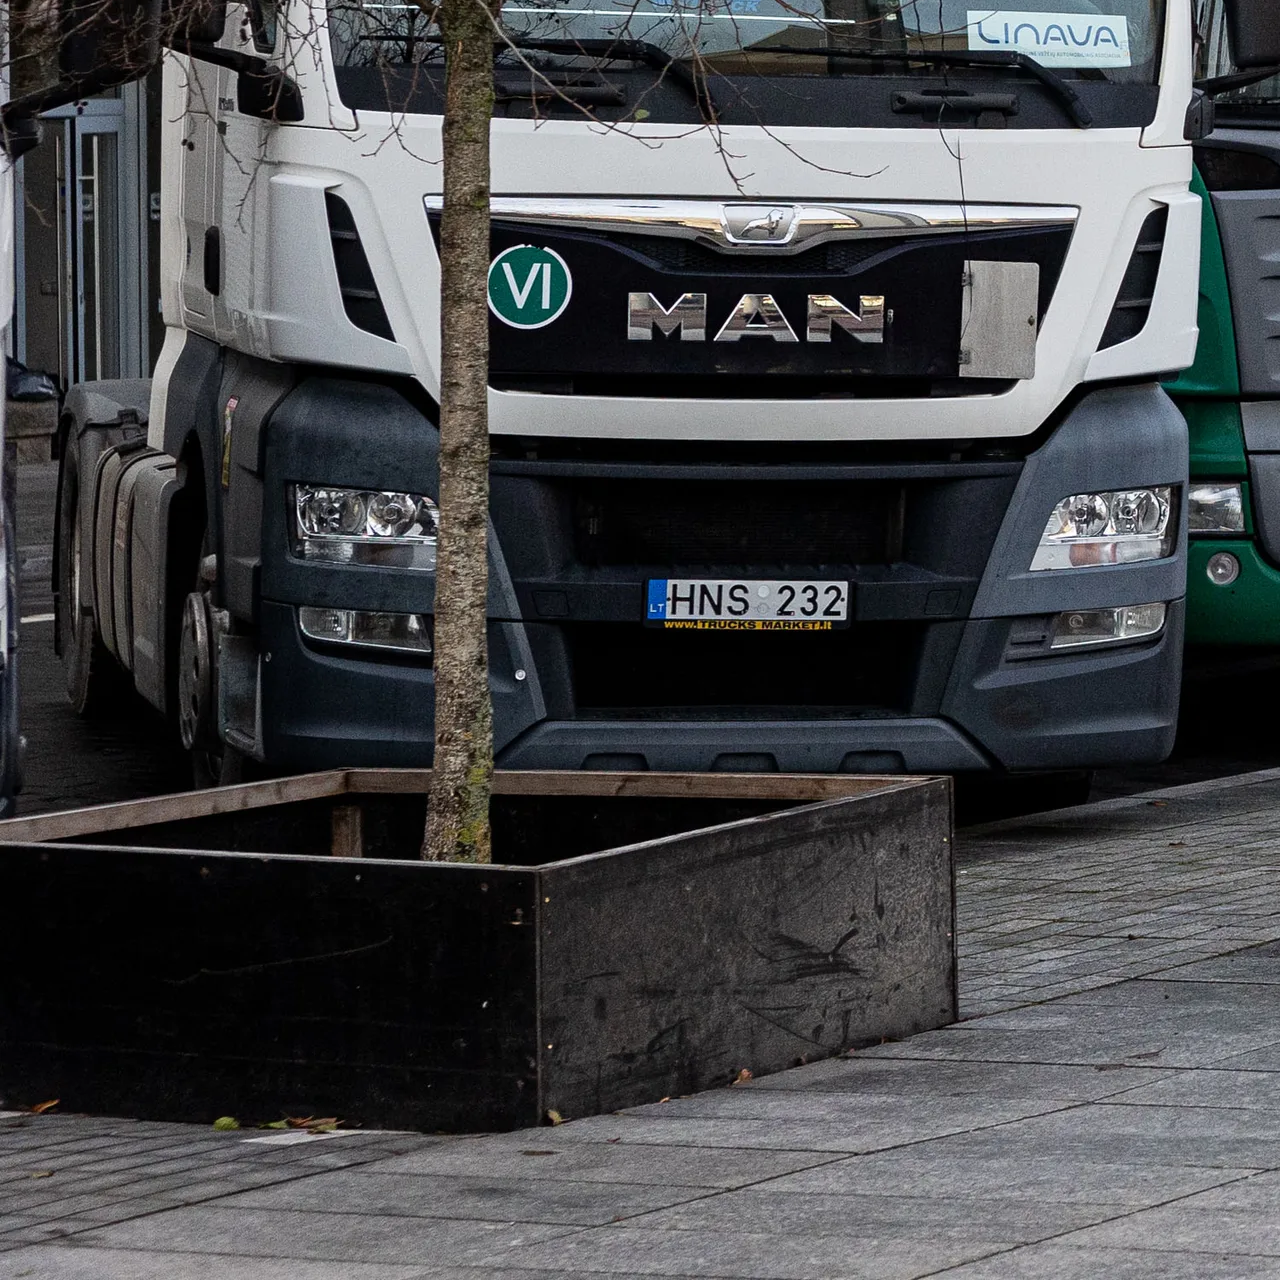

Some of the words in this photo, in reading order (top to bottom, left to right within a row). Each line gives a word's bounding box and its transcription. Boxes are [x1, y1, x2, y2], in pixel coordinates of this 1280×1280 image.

[977, 21, 1119, 48] LINAVA
[501, 263, 551, 310] VI
[627, 292, 884, 343] MAN
[650, 603, 664, 613] LT
[671, 584, 750, 616] HNS
[776, 585, 842, 616] 232
